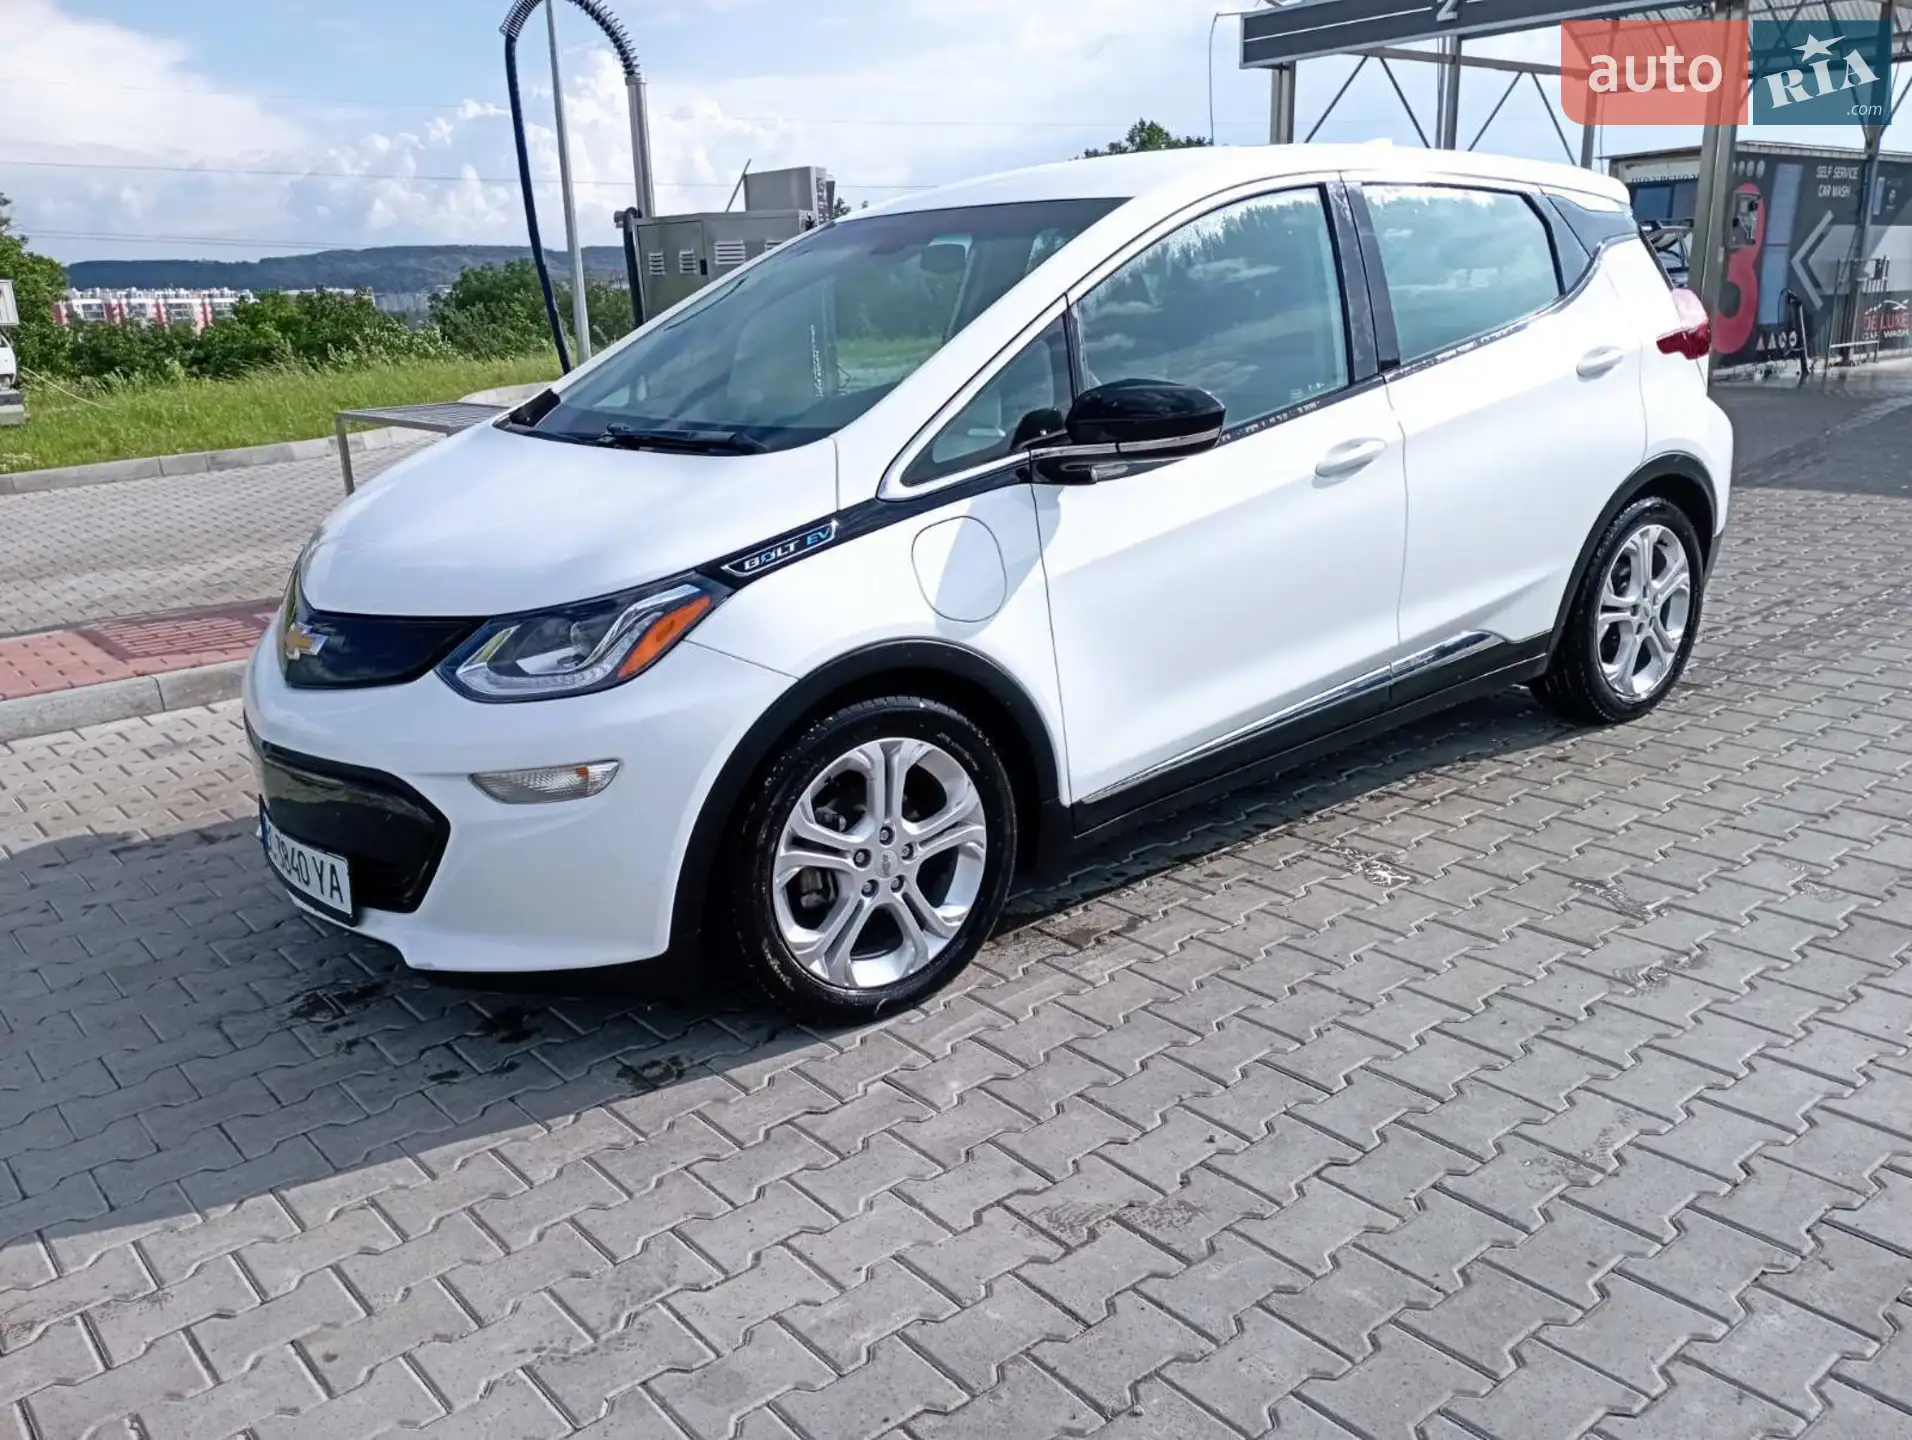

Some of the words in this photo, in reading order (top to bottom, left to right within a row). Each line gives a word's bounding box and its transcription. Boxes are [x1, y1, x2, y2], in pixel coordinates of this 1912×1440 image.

[1436, 0, 1458, 21] 2
[1816, 166, 1832, 178] SELF
[1833, 166, 1859, 180] SERVICE
[1818, 184, 1832, 197] CAR
[1832, 185, 1851, 198] WASH
[744, 540, 800, 570] BOLT
[806, 528, 830, 546] EV
[312, 857, 344, 904] YA
